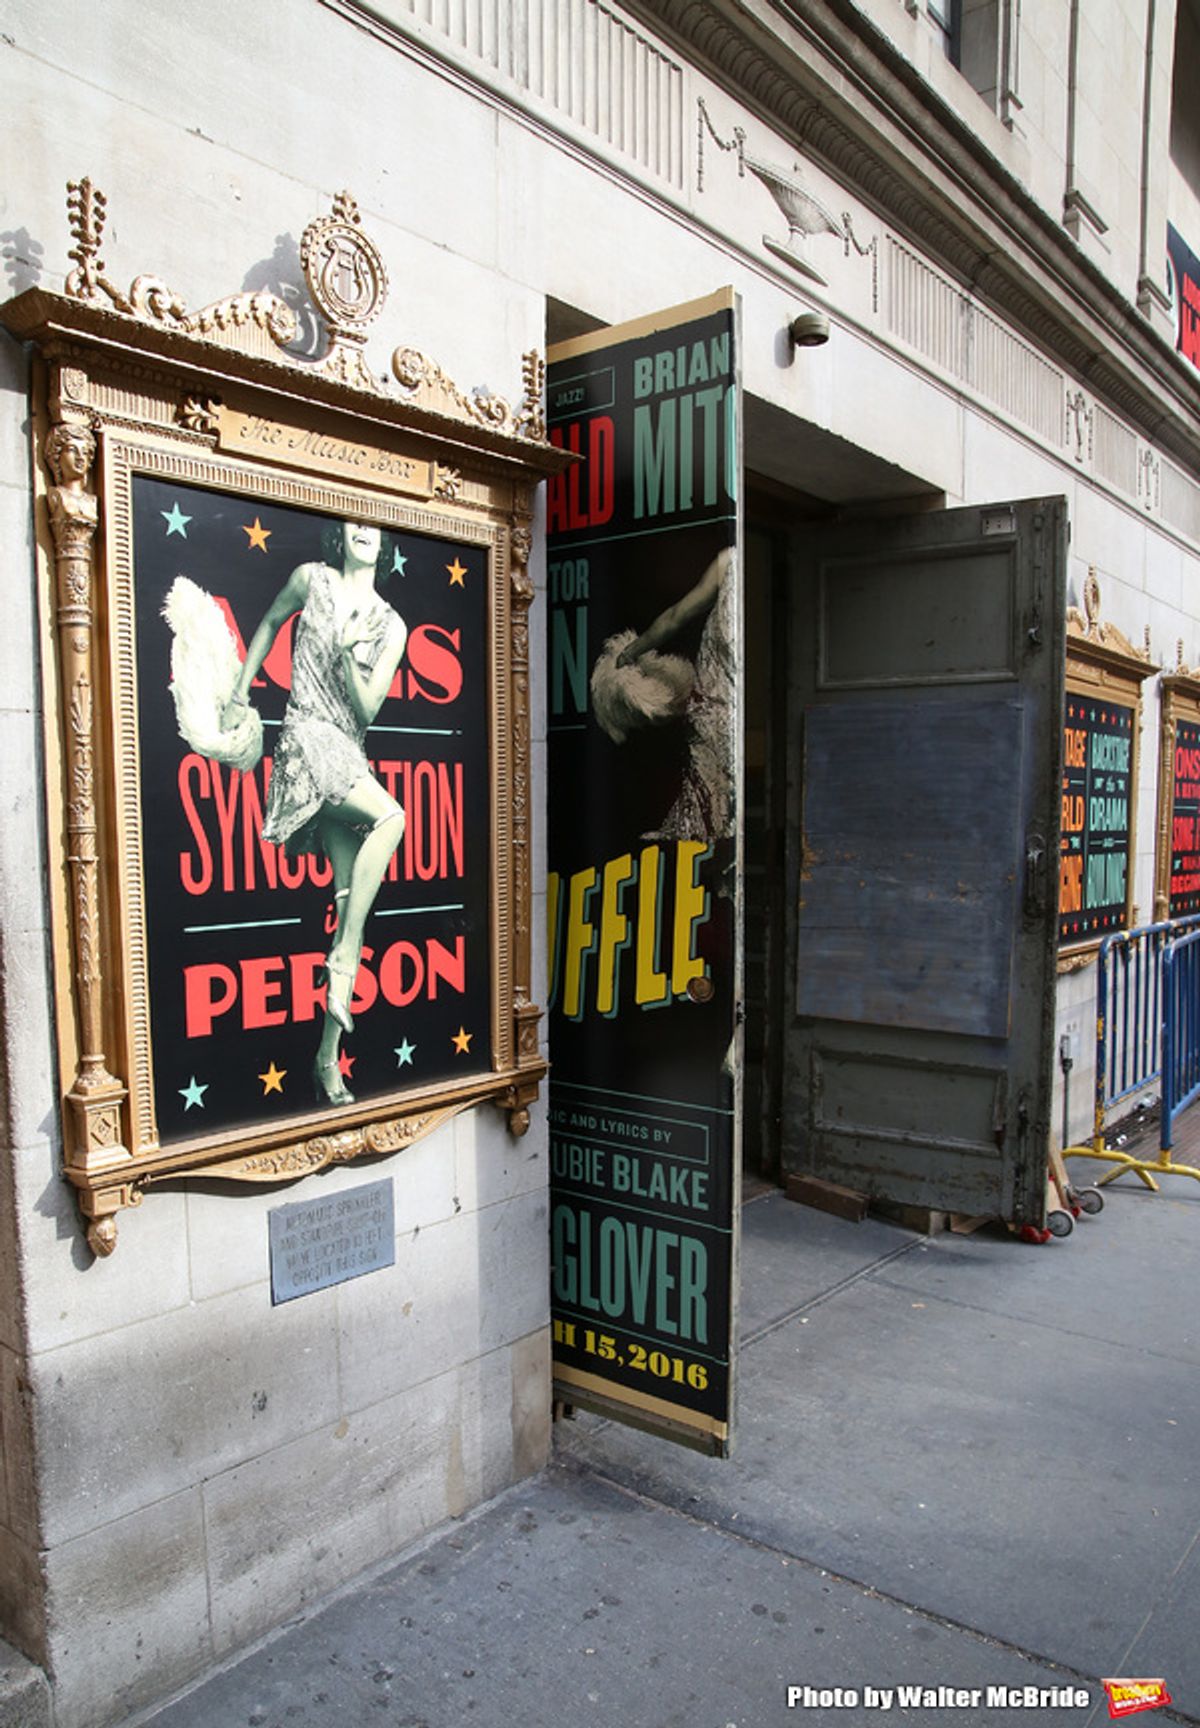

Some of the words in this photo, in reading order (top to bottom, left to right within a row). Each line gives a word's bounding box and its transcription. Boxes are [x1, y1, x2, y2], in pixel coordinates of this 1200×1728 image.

[634, 331, 730, 400] BRIAN
[178, 752, 464, 896] SYNTION
[1090, 796, 1128, 832] DRAMA
[183, 935, 466, 1039] PERSON
[570, 1113, 597, 1130] AND
[601, 1117, 649, 1140] LYRICS
[653, 1129, 672, 1144] BY
[612, 1152, 709, 1212] BLAKE
[553, 1203, 708, 1345] GLOVER
